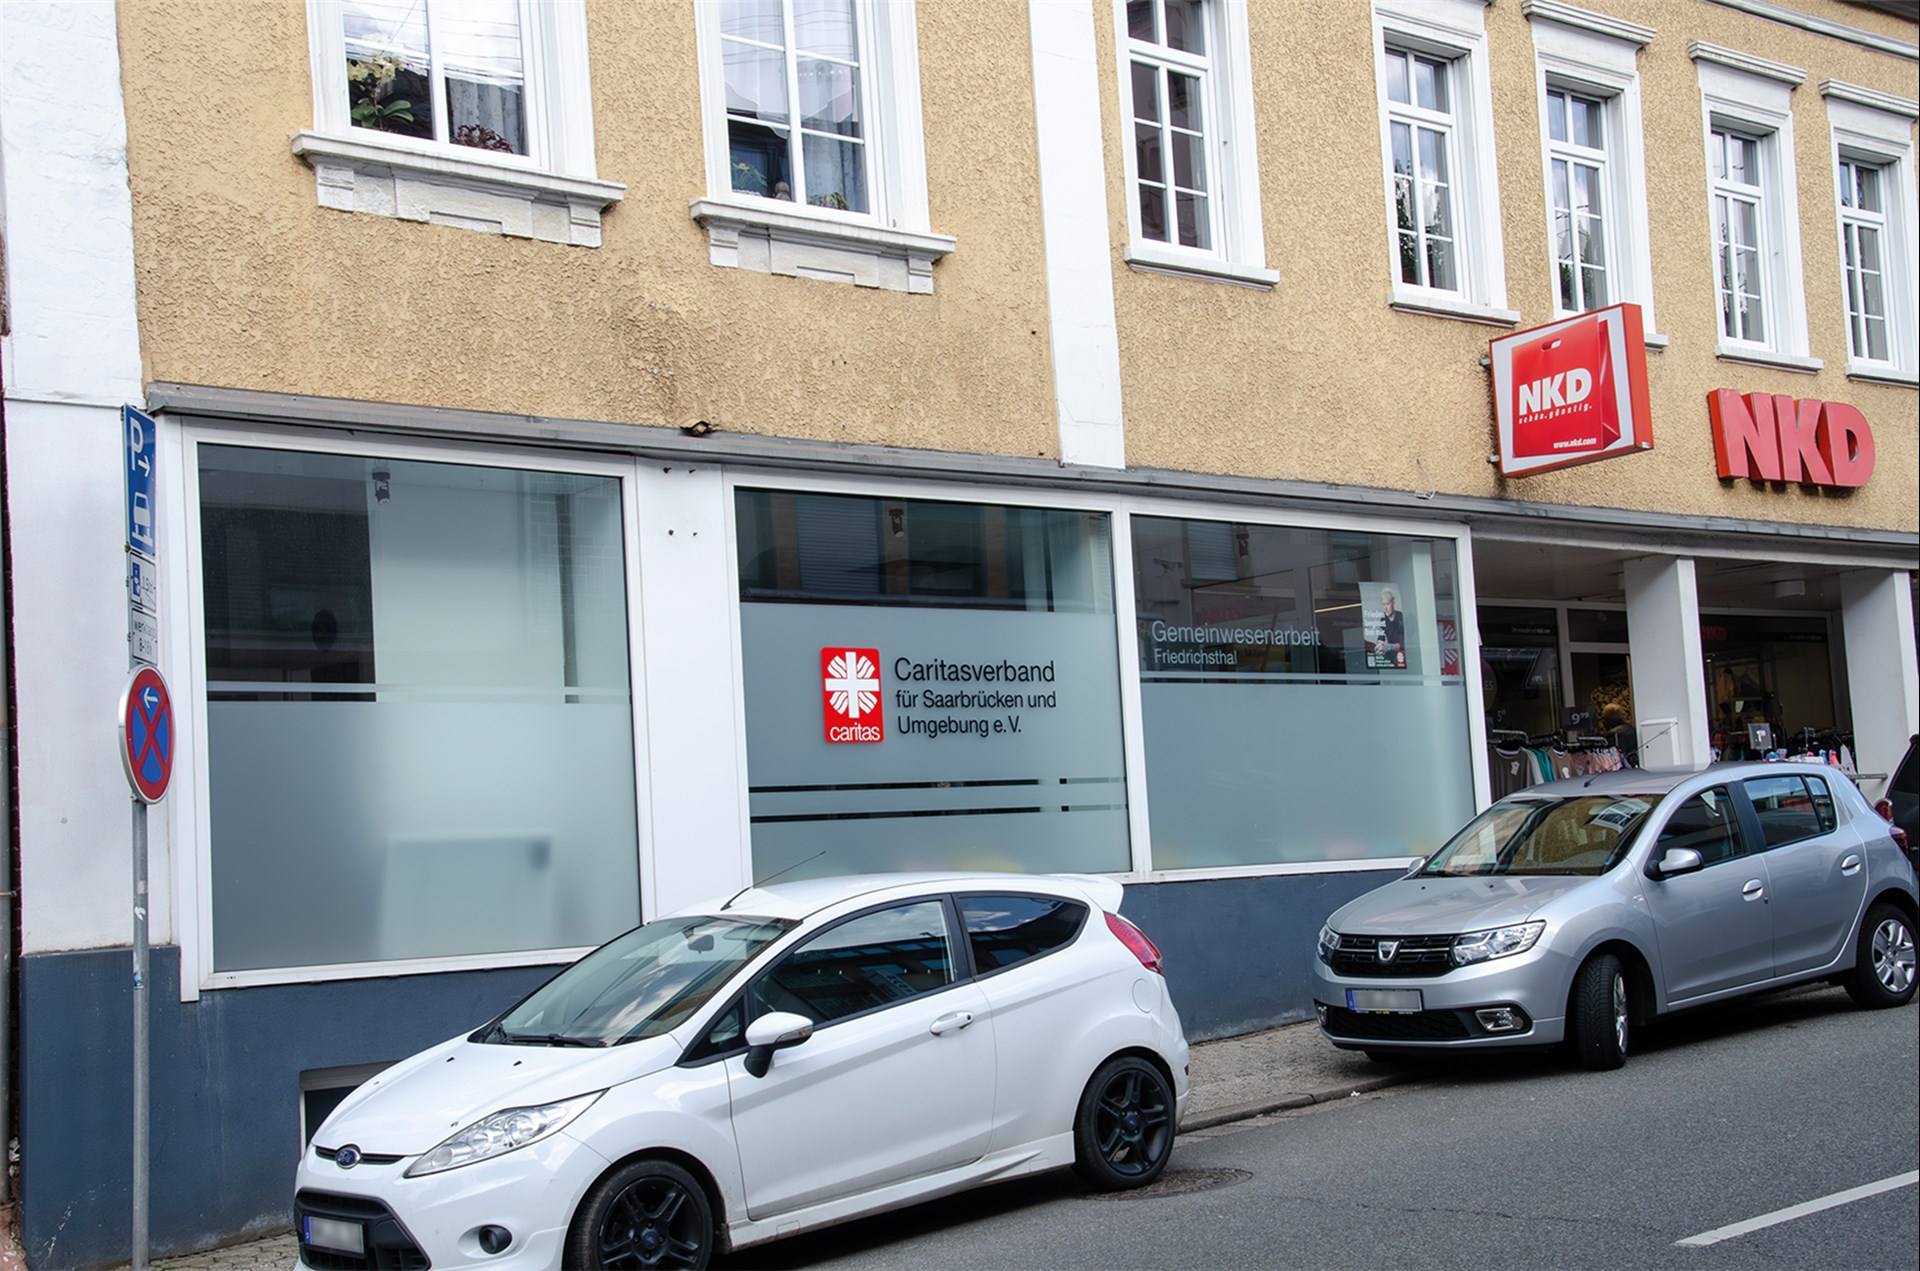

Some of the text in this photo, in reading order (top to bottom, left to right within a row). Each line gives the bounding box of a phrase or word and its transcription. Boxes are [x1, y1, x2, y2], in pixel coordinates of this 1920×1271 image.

[1518, 367, 1593, 417] NKD
[130, 417, 144, 470] P
[1553, 437, 1597, 449] www.nkd.com
[1708, 388, 1876, 487] NKD
[1152, 620, 1321, 647] Gemeinwesenarbeit
[1153, 648, 1238, 665] Friedrichsthal
[894, 656, 1055, 683] Caritasverband
[895, 689, 1057, 709] für Saarbrücken und
[829, 721, 881, 742] caritas
[897, 715, 1022, 739] Umgebung e.V.
